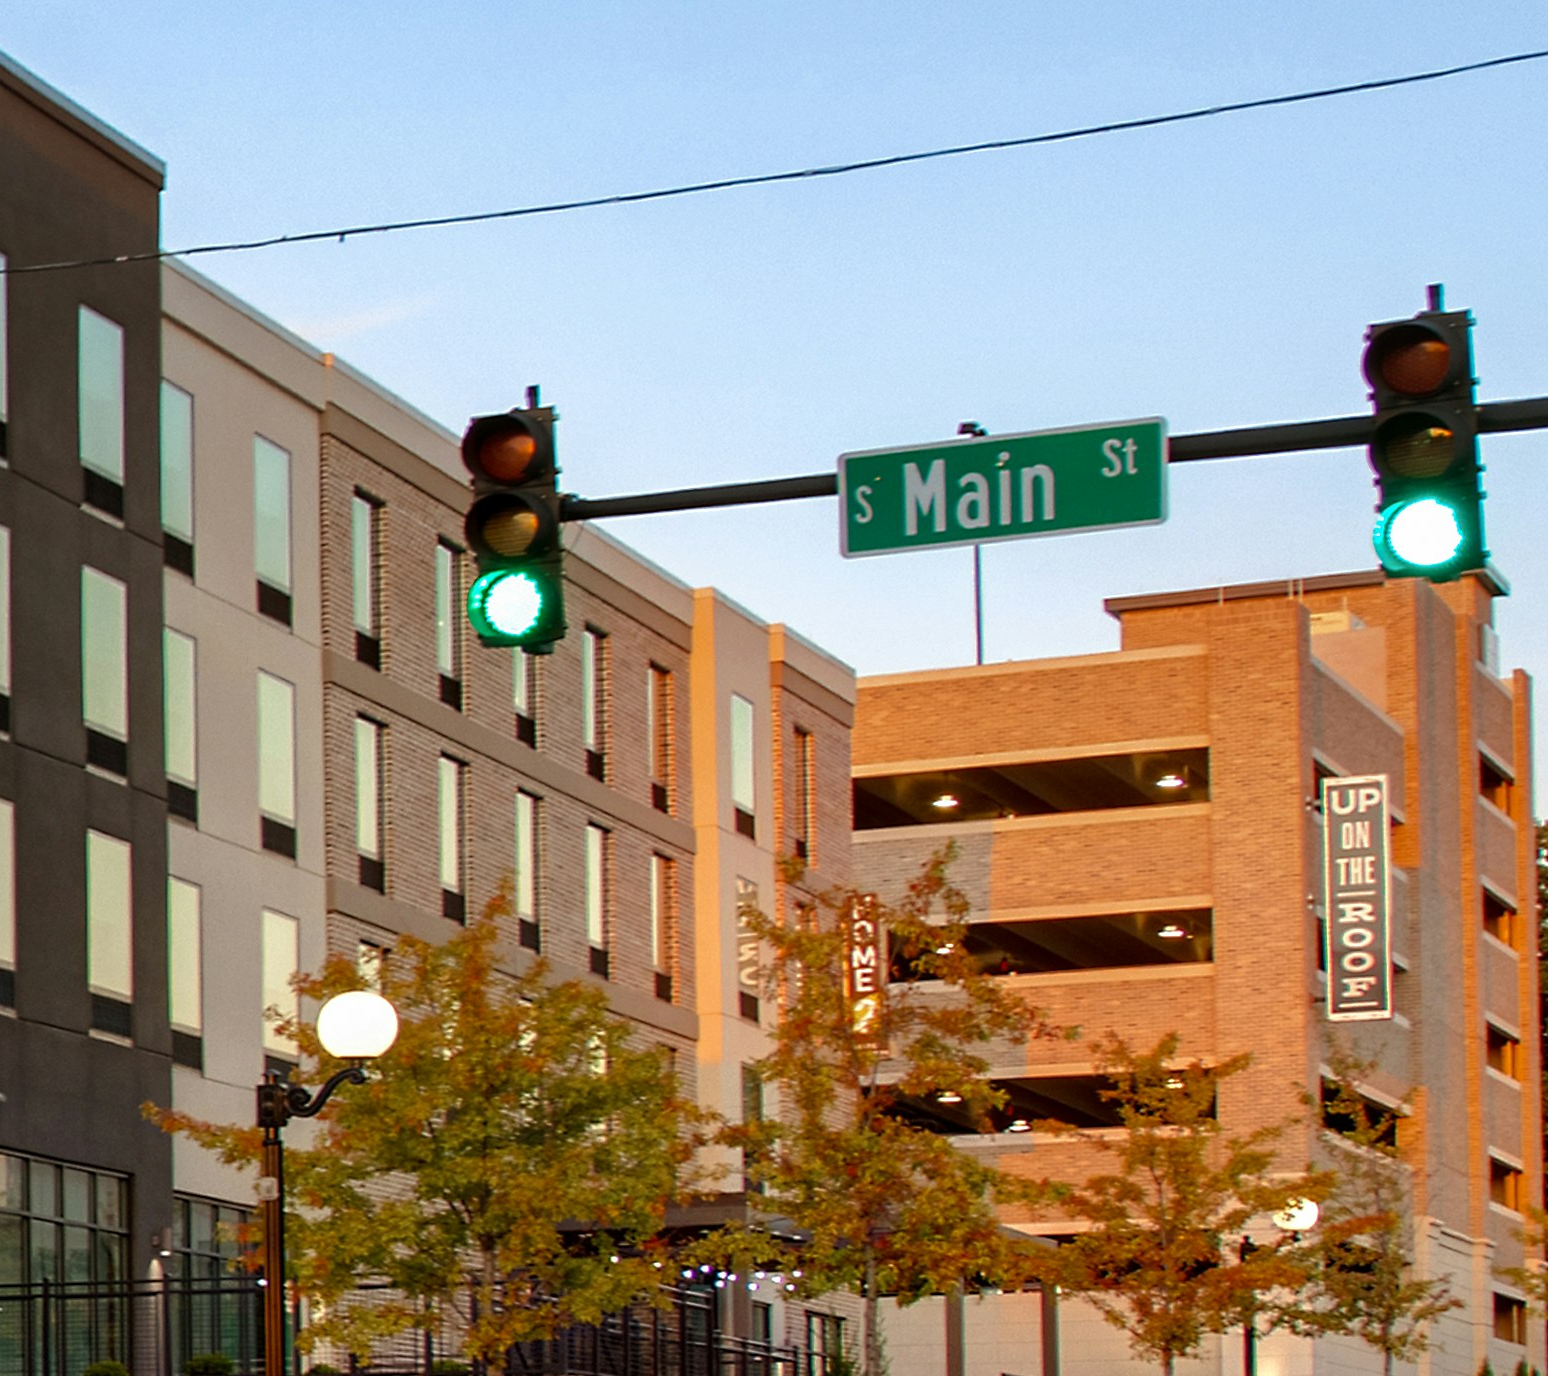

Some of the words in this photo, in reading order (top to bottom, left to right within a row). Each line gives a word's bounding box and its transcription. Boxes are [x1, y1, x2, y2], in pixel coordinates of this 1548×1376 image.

[855, 484, 874, 524] S
[903, 452, 1056, 537] Main
[1100, 437, 1138, 478] St
[1330, 786, 1382, 816] UP
[1341, 820, 1371, 850] ON
[1335, 855, 1377, 887] THE
[1337, 901, 1378, 999] ROOF
